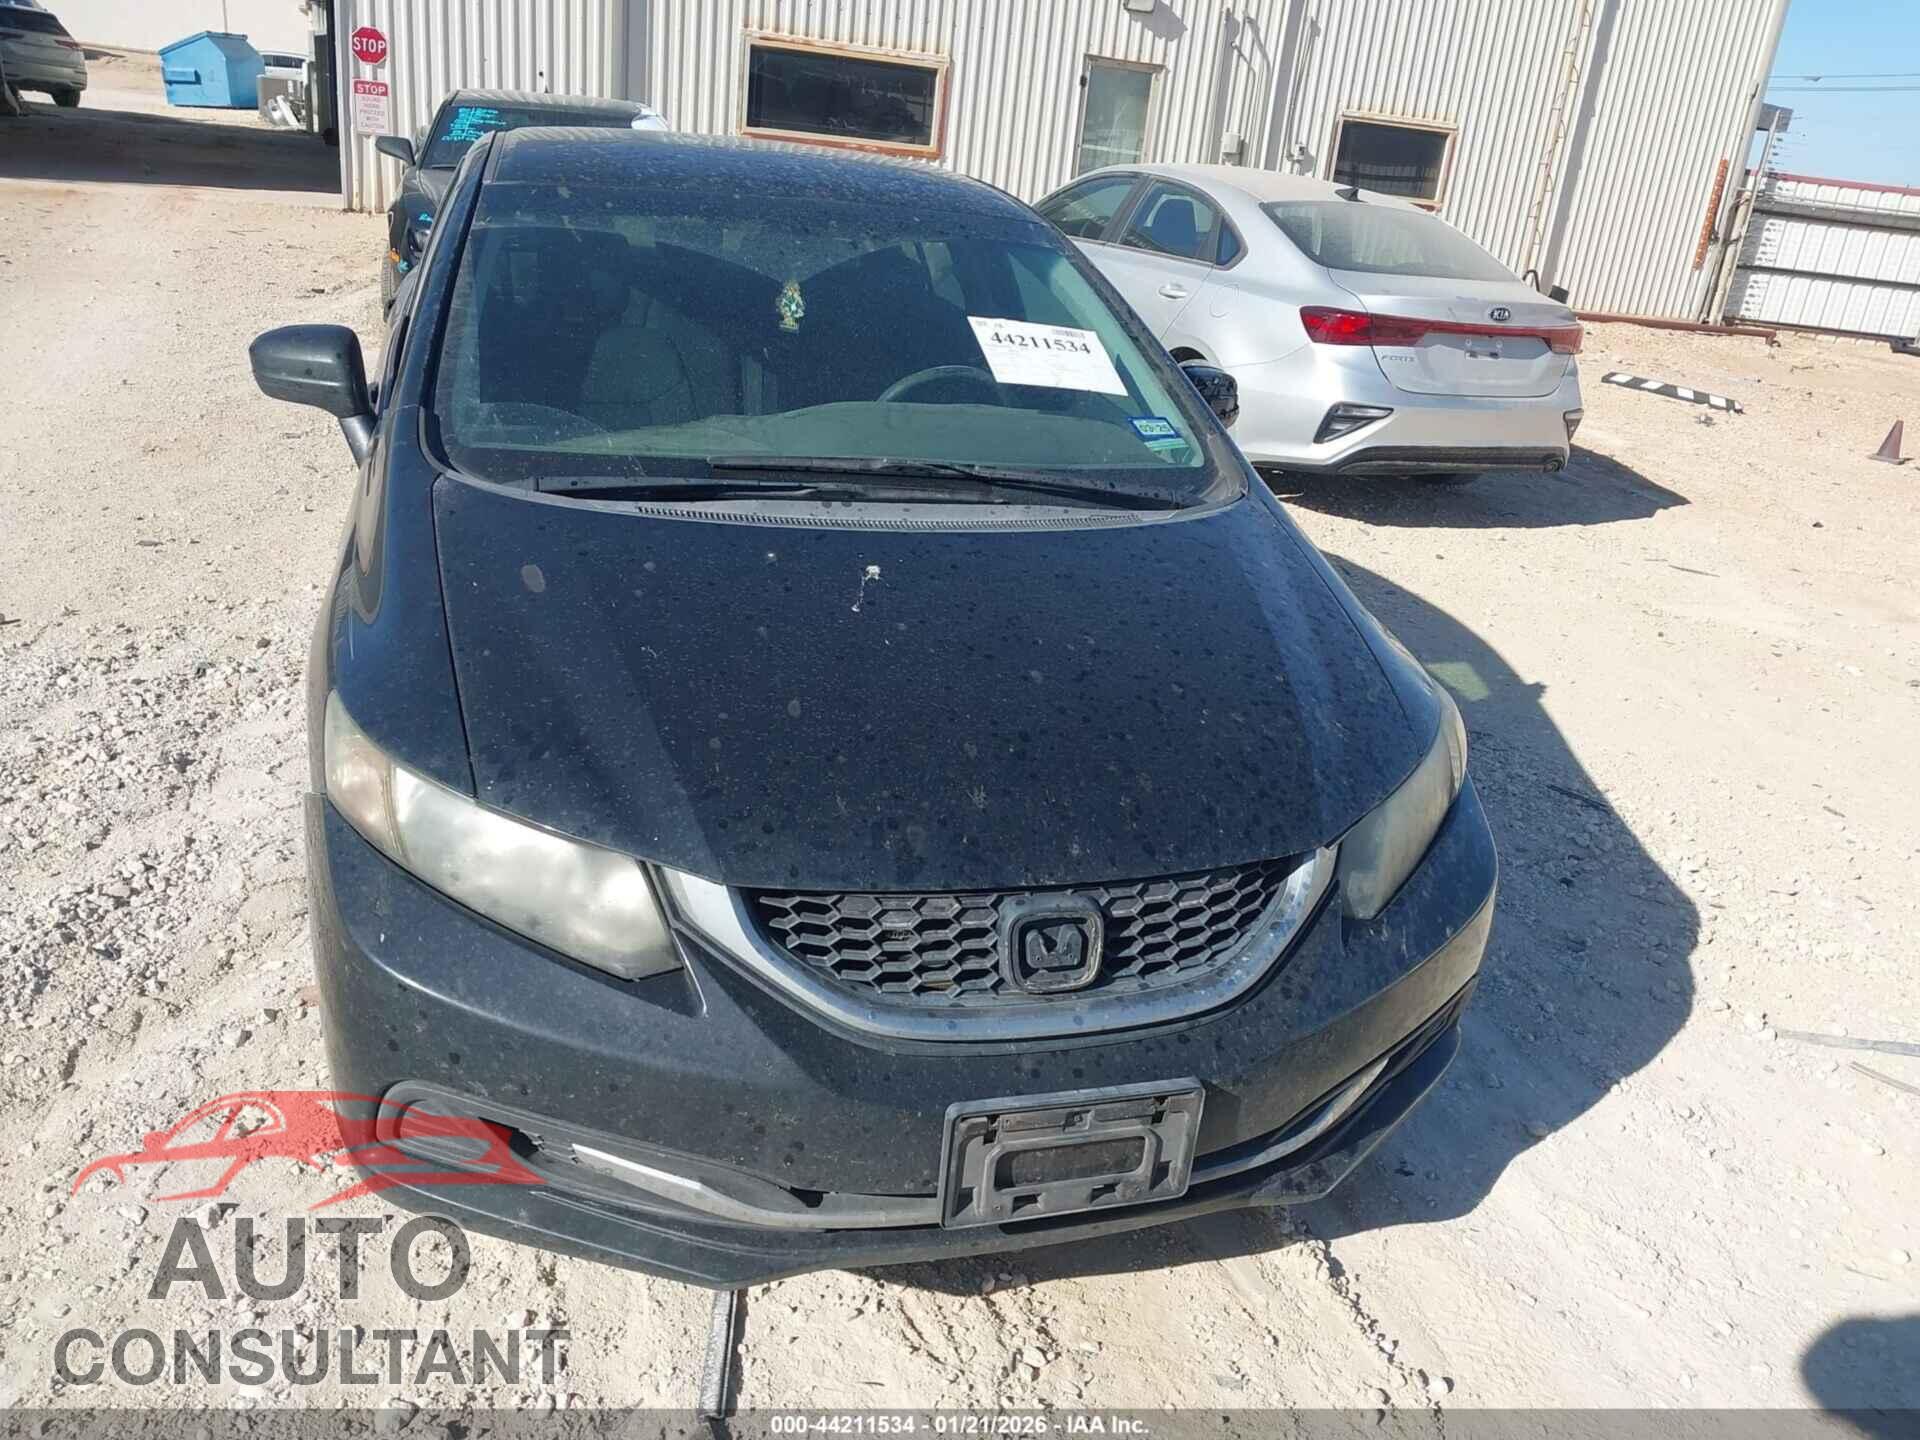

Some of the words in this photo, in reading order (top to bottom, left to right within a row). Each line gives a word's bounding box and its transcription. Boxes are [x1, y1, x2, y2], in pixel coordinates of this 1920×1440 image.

[353, 36, 386, 53] STOP
[357, 83, 386, 94] STOP
[1493, 309, 1509, 320] KIA
[991, 332, 1091, 354] 44211534
